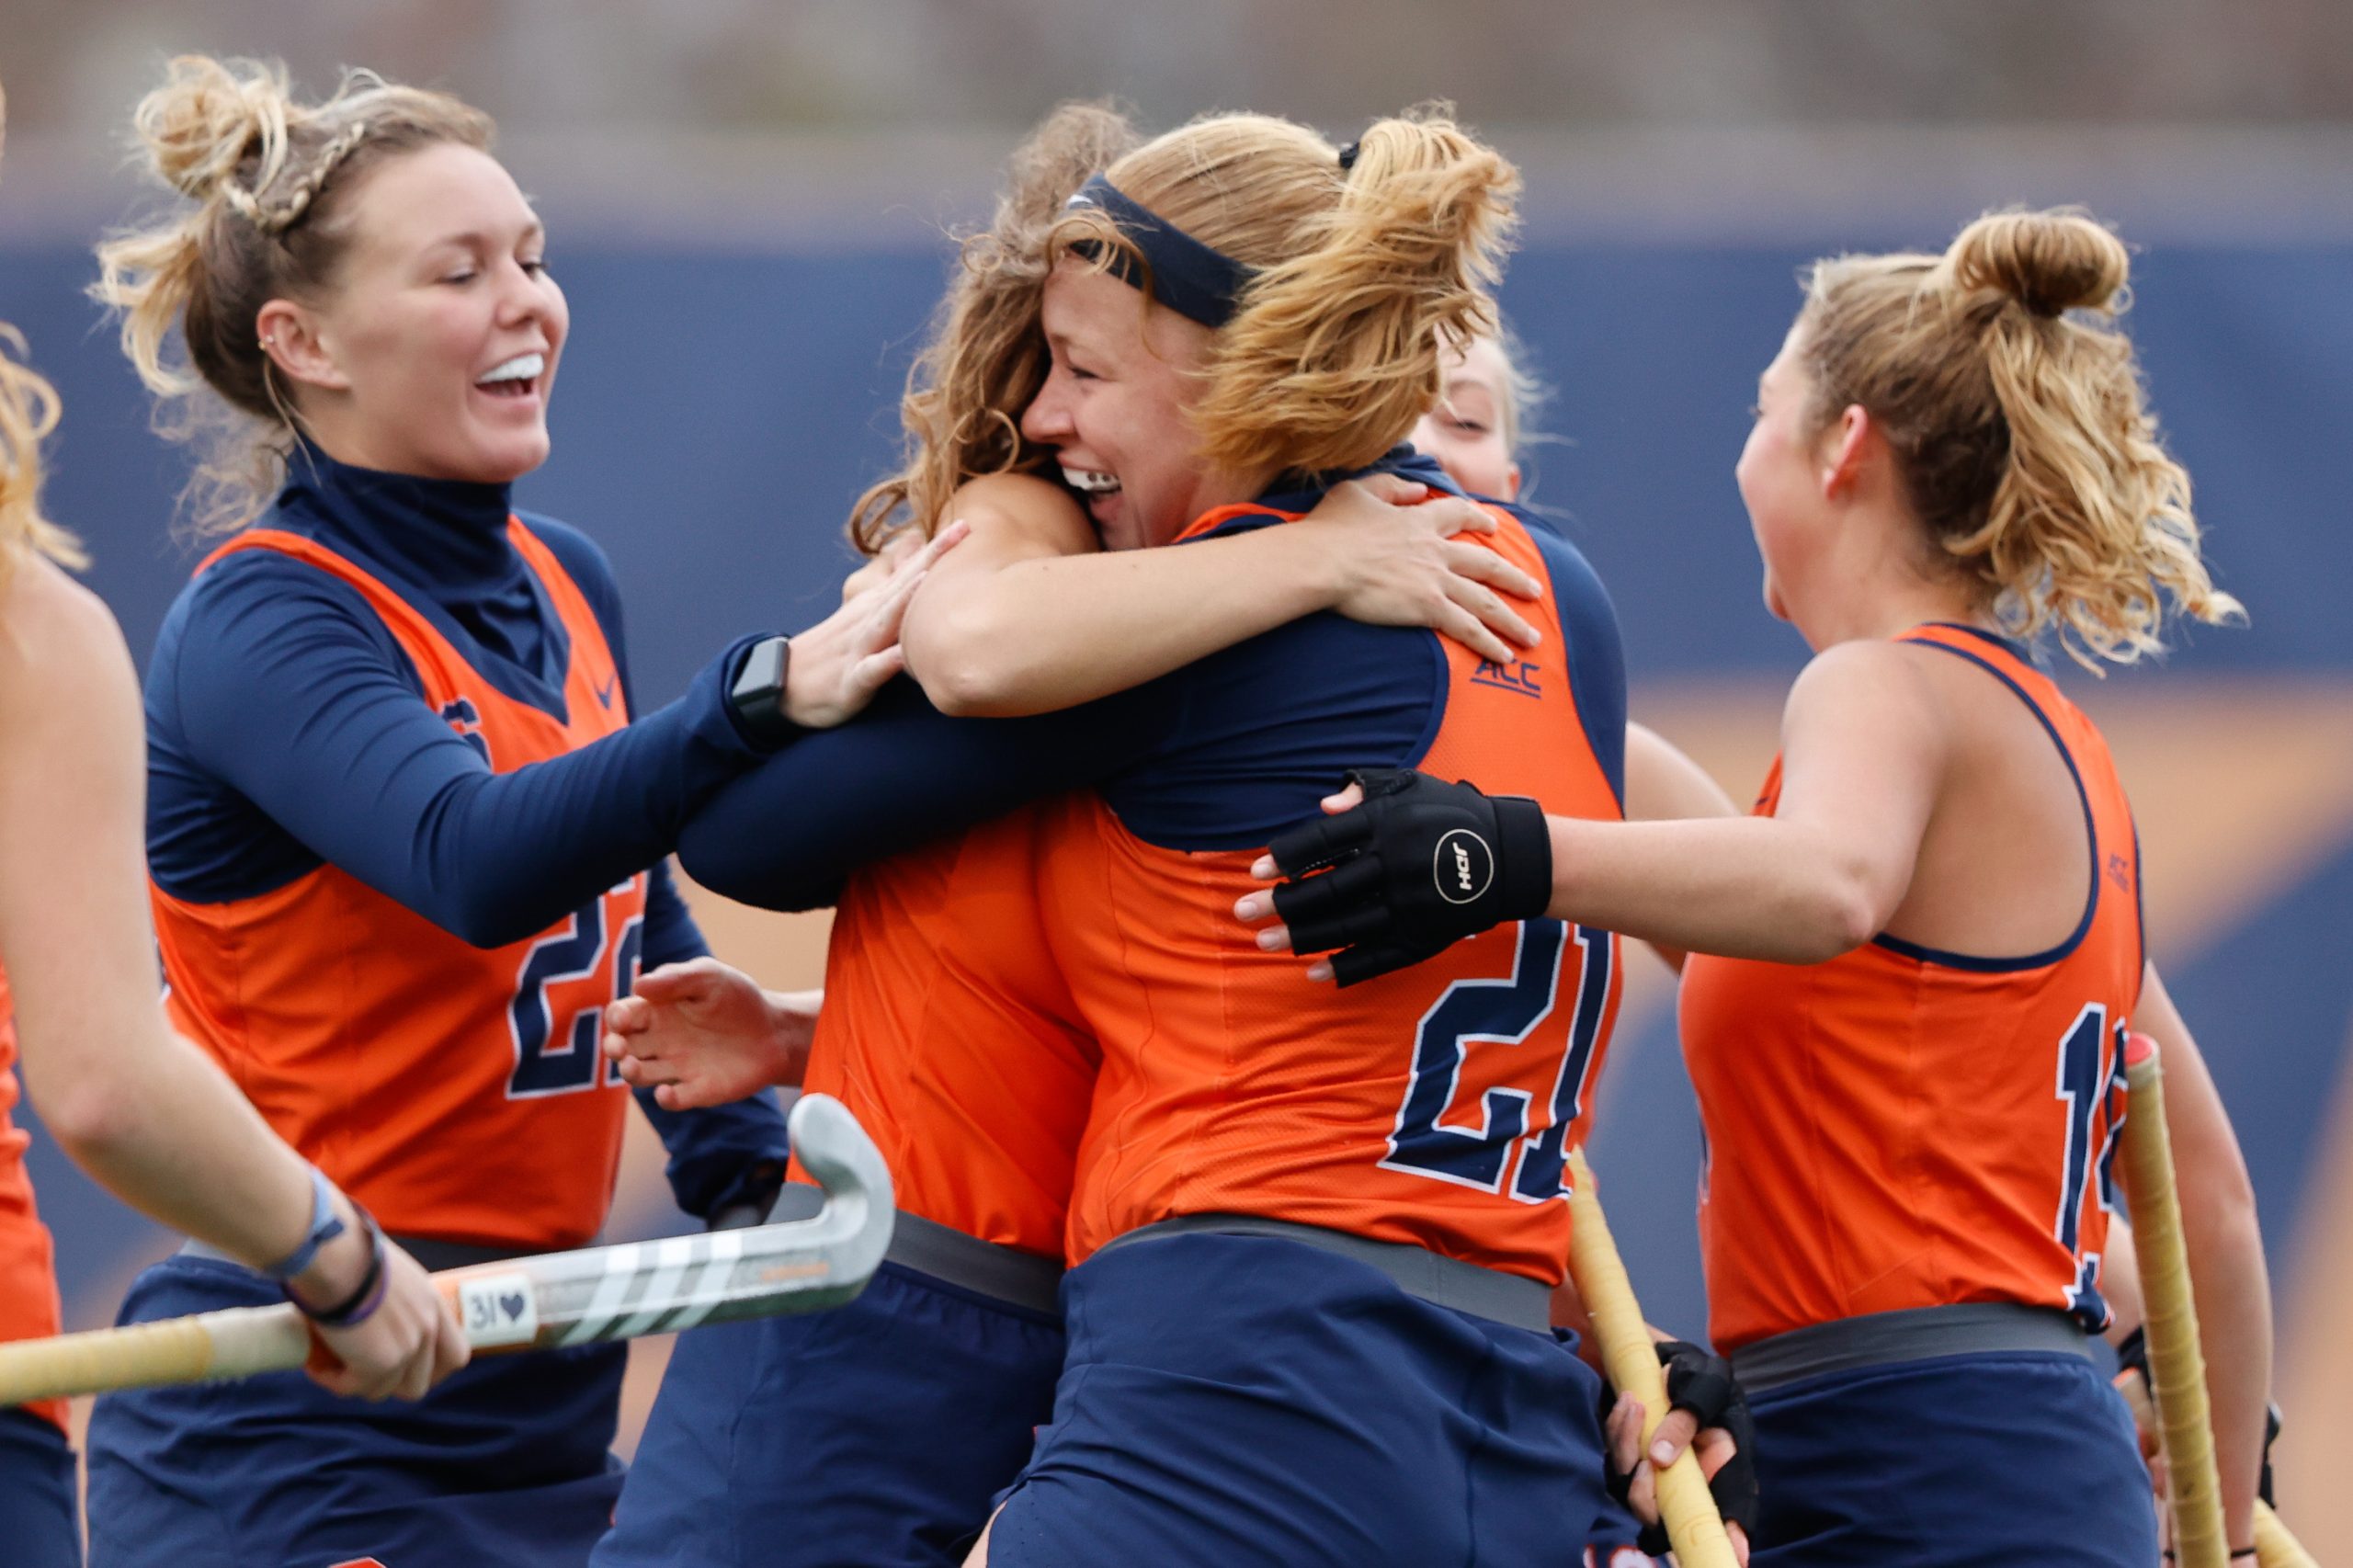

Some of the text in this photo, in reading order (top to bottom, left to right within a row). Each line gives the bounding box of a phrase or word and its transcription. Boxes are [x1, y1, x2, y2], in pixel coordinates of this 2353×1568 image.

[1474, 656, 1541, 691] ACC
[1452, 841, 1472, 891] JDH
[1377, 919, 1615, 1204] 21
